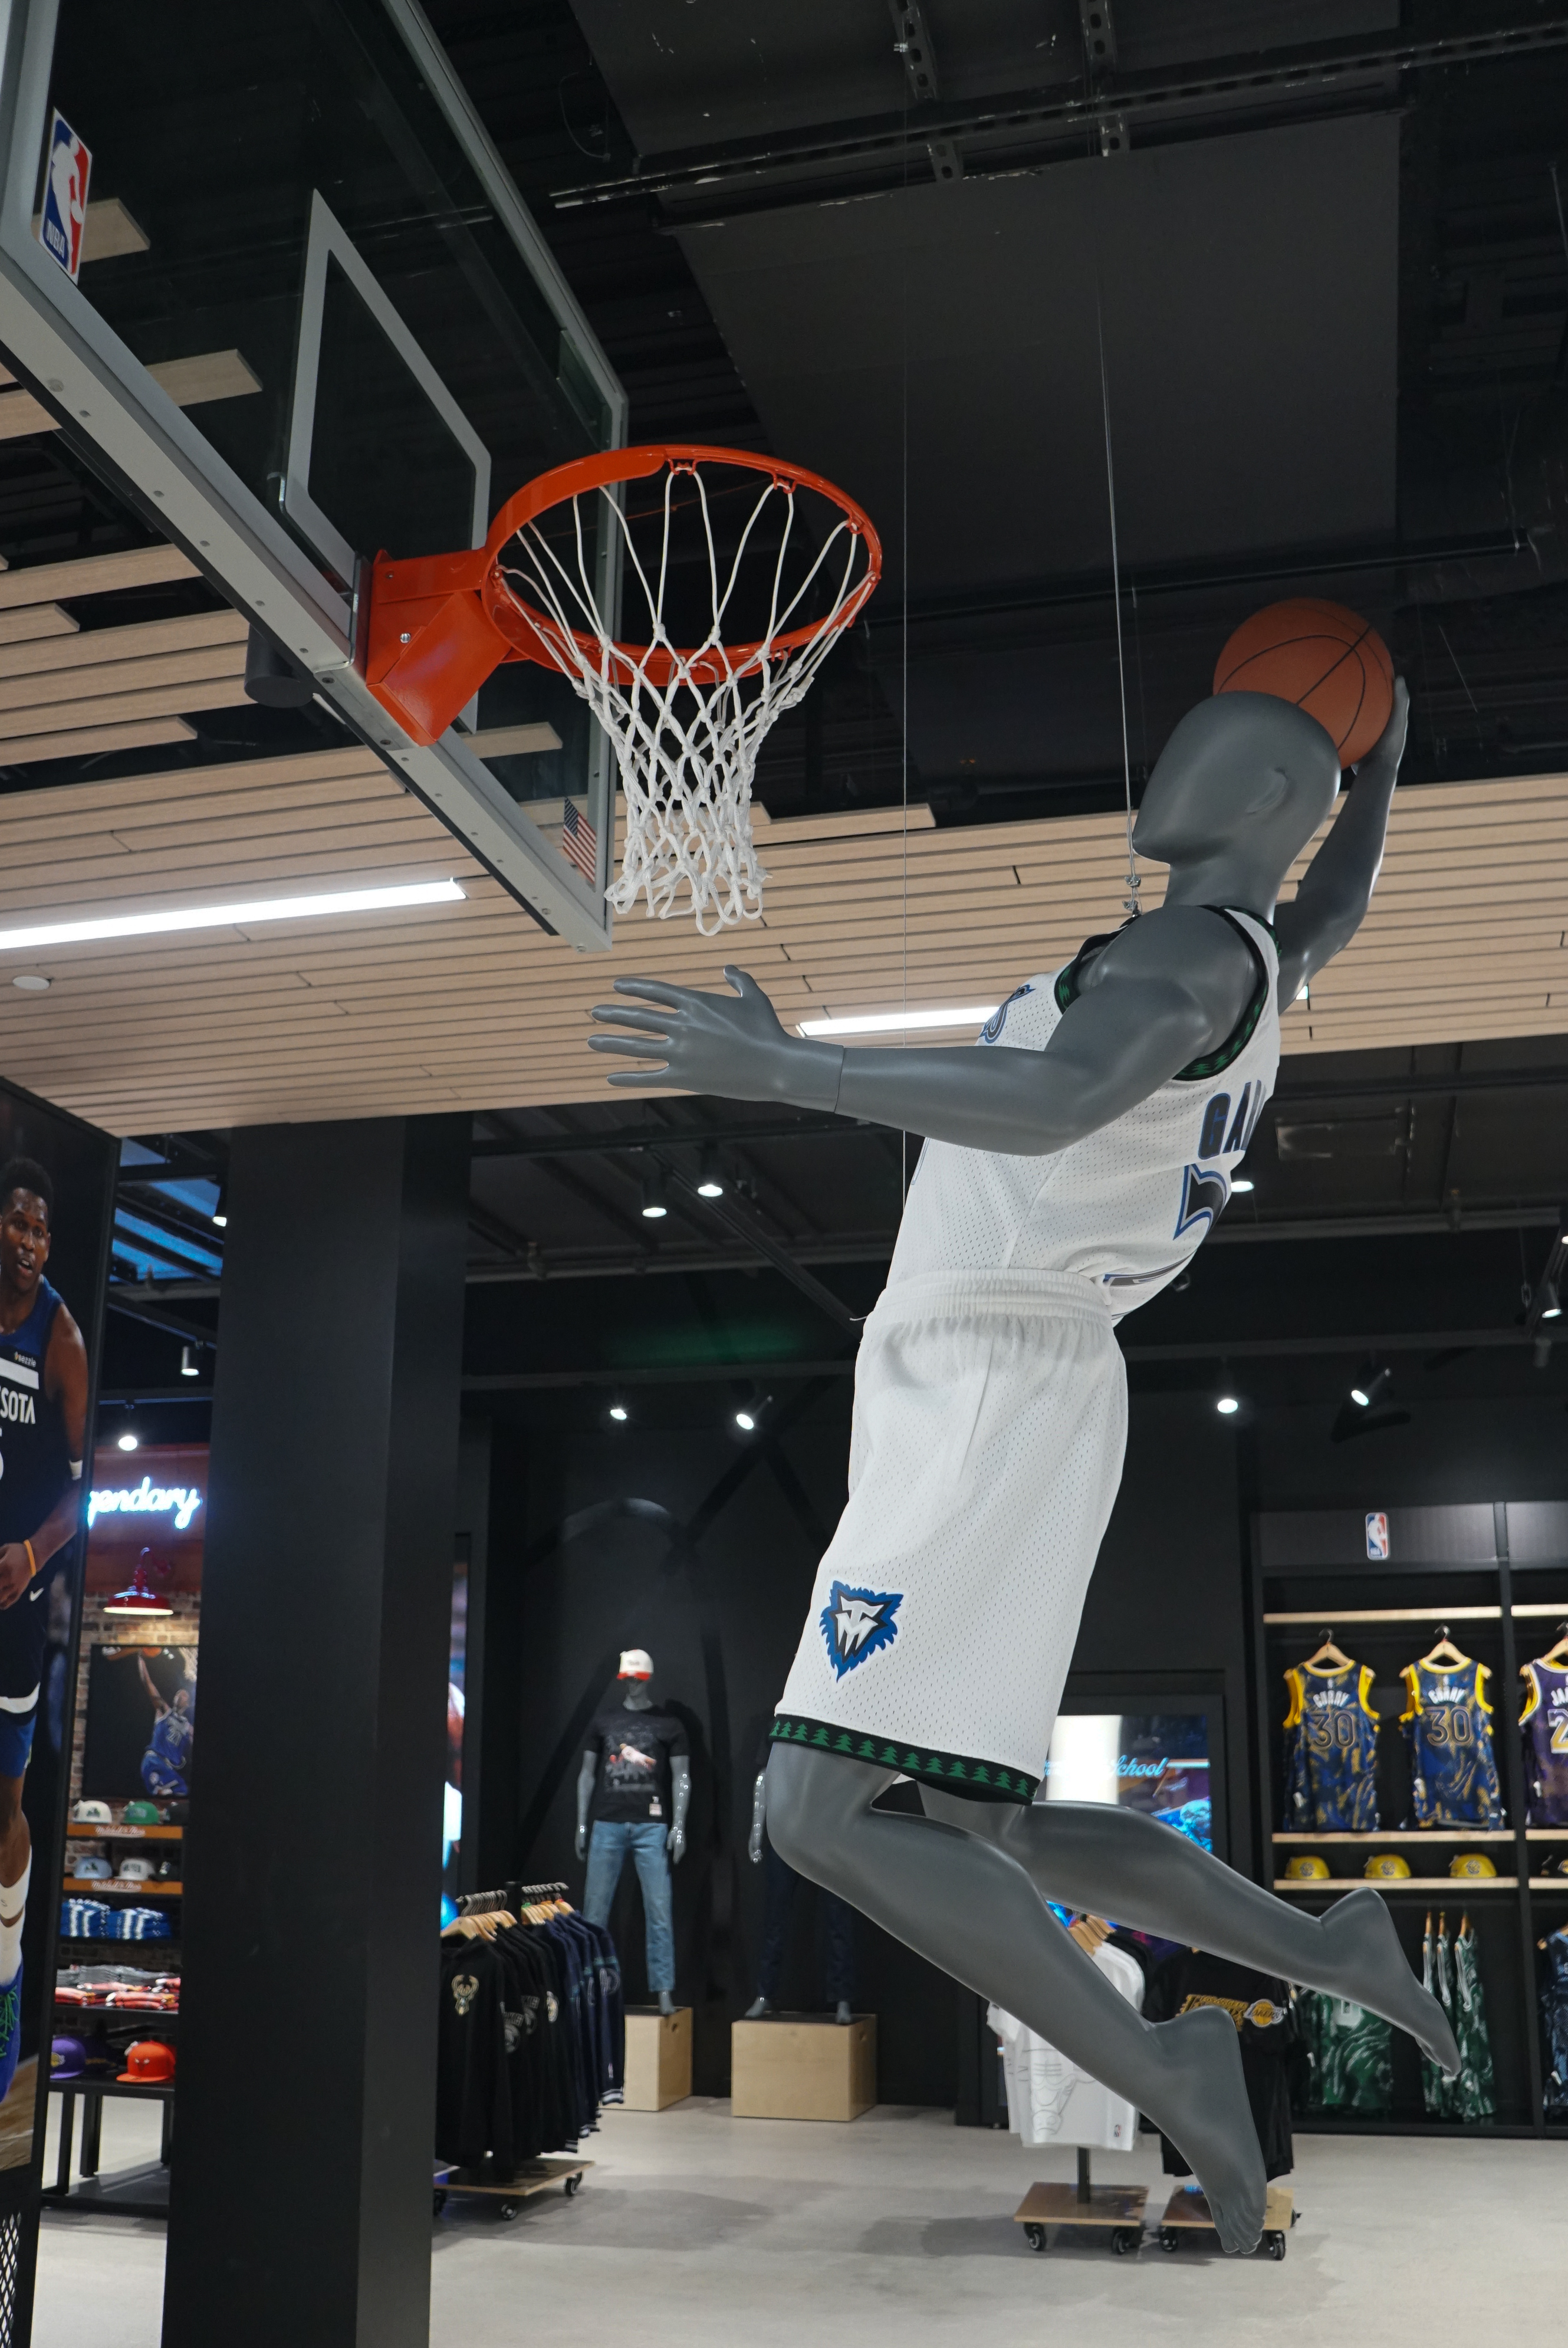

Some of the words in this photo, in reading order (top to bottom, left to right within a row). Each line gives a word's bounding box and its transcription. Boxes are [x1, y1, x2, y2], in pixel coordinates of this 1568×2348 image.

[46, 218, 65, 260] NBA
[1313, 1690, 1350, 1708] CURRY
[1428, 1686, 1466, 1705] CURRY
[1307, 1710, 1356, 1749] 30
[1425, 1706, 1472, 1746] 30
